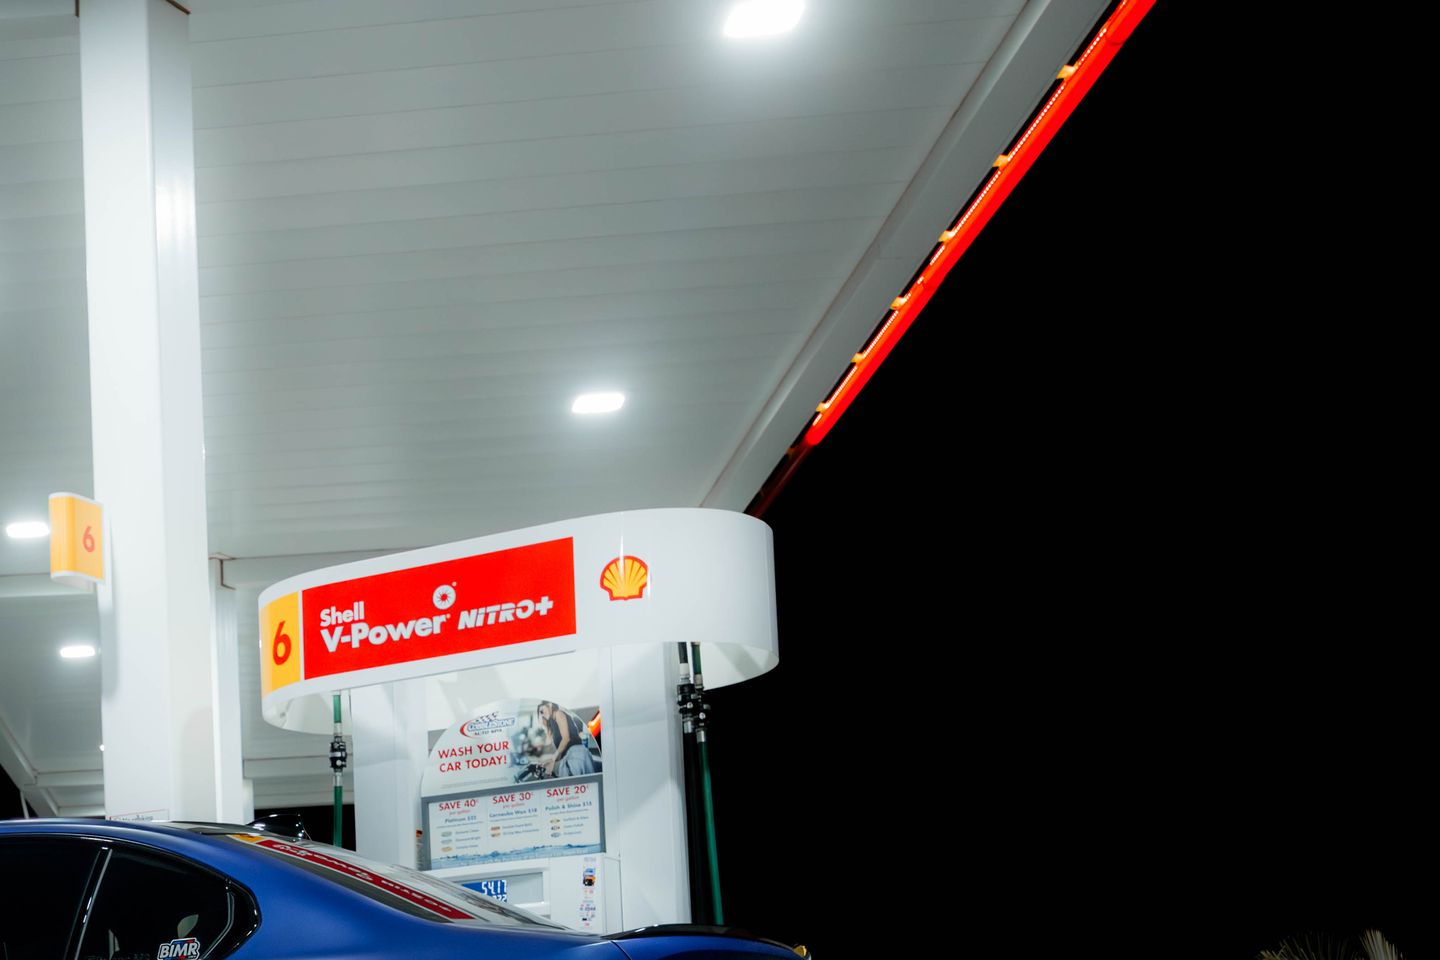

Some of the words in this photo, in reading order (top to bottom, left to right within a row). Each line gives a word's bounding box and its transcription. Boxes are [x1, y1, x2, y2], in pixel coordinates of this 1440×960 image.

[82, 525, 96, 553] 6
[319, 601, 365, 627] Shell
[272, 620, 292, 666] 6
[438, 746, 473, 759] WASH
[477, 741, 509, 754] YOUR
[439, 761, 461, 773] CAR
[465, 755, 507, 769] TODAY!
[492, 793, 515, 804] SAVE
[546, 786, 569, 798] SAVE
[438, 801, 461, 811] SAVE
[160, 942, 198, 959] BIMR
